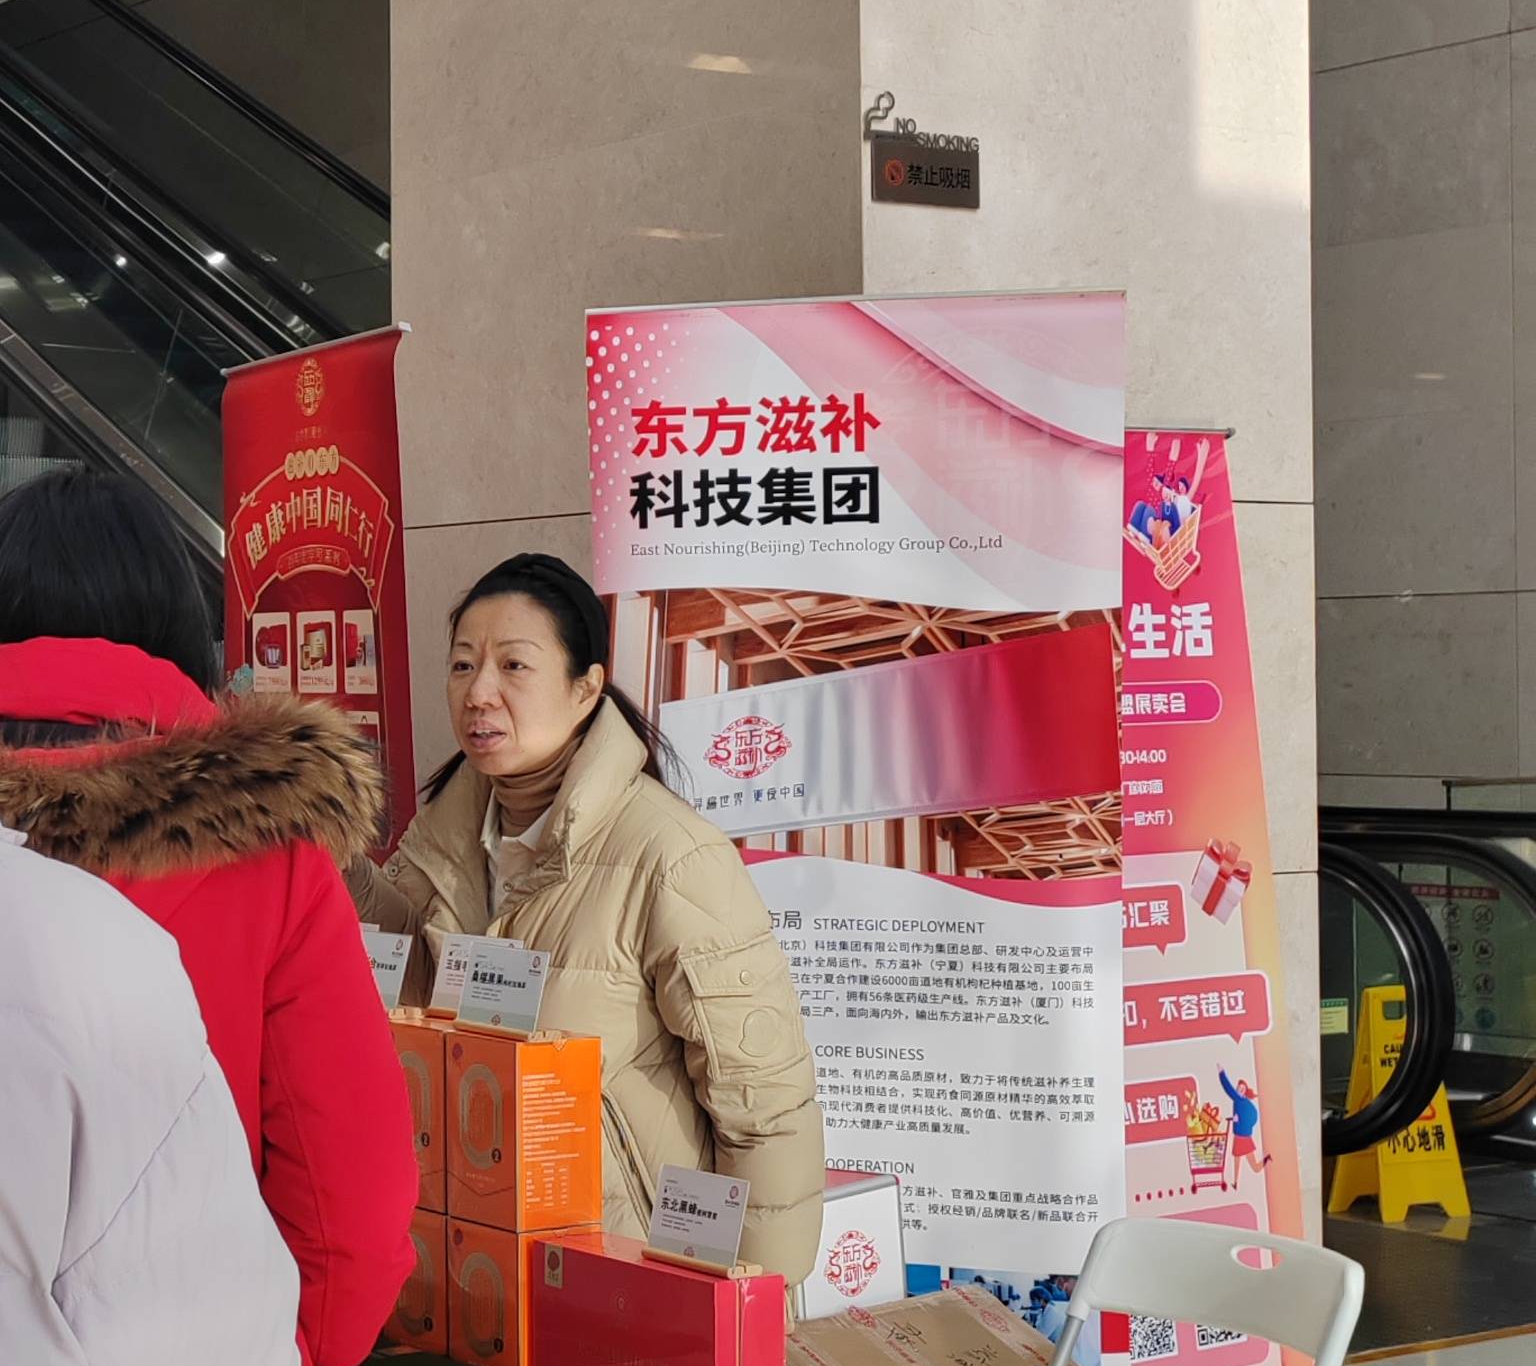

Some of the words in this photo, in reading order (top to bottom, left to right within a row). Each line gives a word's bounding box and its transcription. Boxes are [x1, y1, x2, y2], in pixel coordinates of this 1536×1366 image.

[894, 117, 917, 135] NO
[916, 132, 980, 154] SMOKING
[907, 164, 971, 189] 禁止吸烟
[630, 392, 882, 458] 东方滋补
[629, 466, 881, 529] 科技集团
[630, 544, 660, 556] East
[664, 540, 806, 557] Nourishing(Beijing)
[809, 537, 895, 554] Technology
[899, 537, 945, 553] Group
[948, 535, 1003, 552] Co.,Ltd
[1129, 602, 1215, 659] 生活
[813, 918, 889, 932] STRATEGIC
[891, 919, 985, 934] DEPLOYMENT
[815, 1045, 852, 1058] CORE
[856, 1046, 925, 1061] BUSINESS
[825, 1158, 915, 1175] OOPERATION
